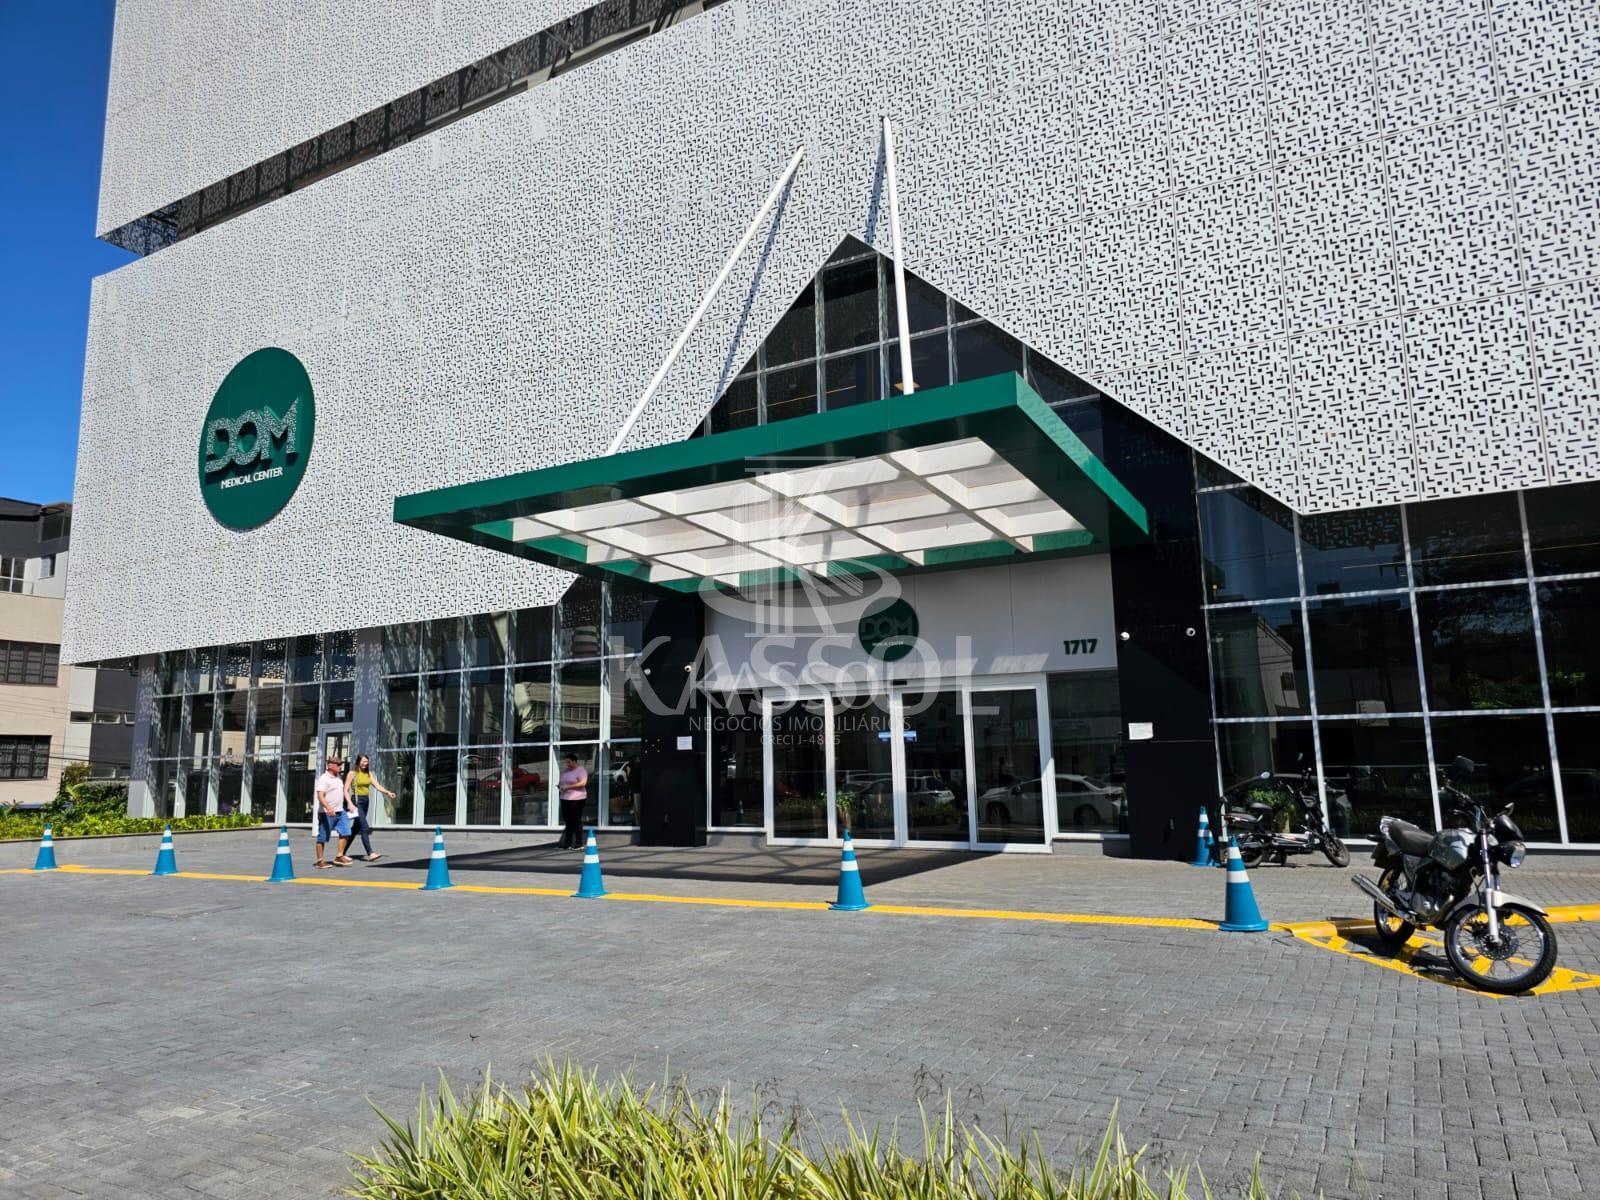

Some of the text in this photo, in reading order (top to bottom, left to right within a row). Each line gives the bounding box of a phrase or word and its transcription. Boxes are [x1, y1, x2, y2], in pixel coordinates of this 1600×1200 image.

[205, 397, 299, 473] DOM
[220, 466, 284, 490] MEDICAL CENTER
[860, 616, 913, 640] DOM
[1063, 638, 1098, 655] 1717
